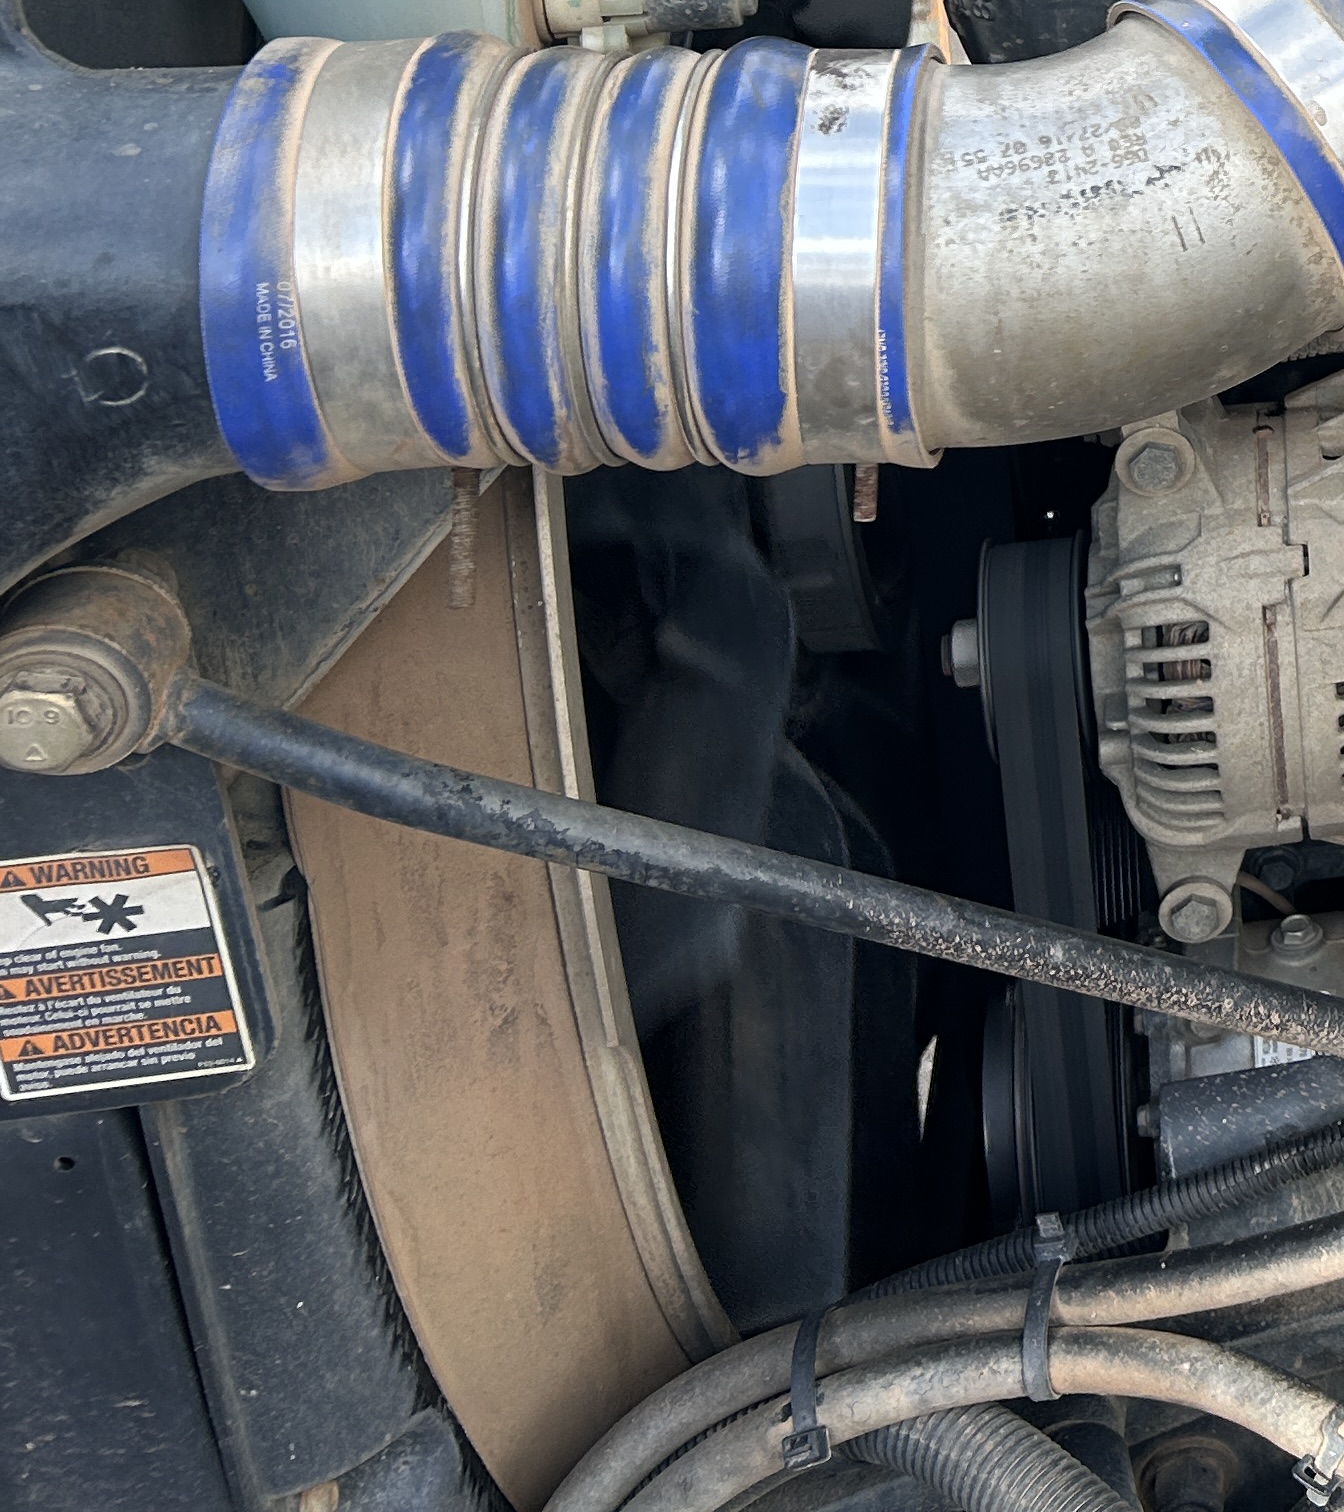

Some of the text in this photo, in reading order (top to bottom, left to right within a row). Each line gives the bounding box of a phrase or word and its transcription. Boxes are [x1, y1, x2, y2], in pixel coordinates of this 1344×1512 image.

[255, 281, 278, 383] MADE IN CHINA
[276, 280, 298, 350] 07/2016
[28, 855, 151, 885] WARNING
[24, 954, 217, 998] AVERTISSEMENT
[52, 1015, 222, 1055] ADVERTENCIA
